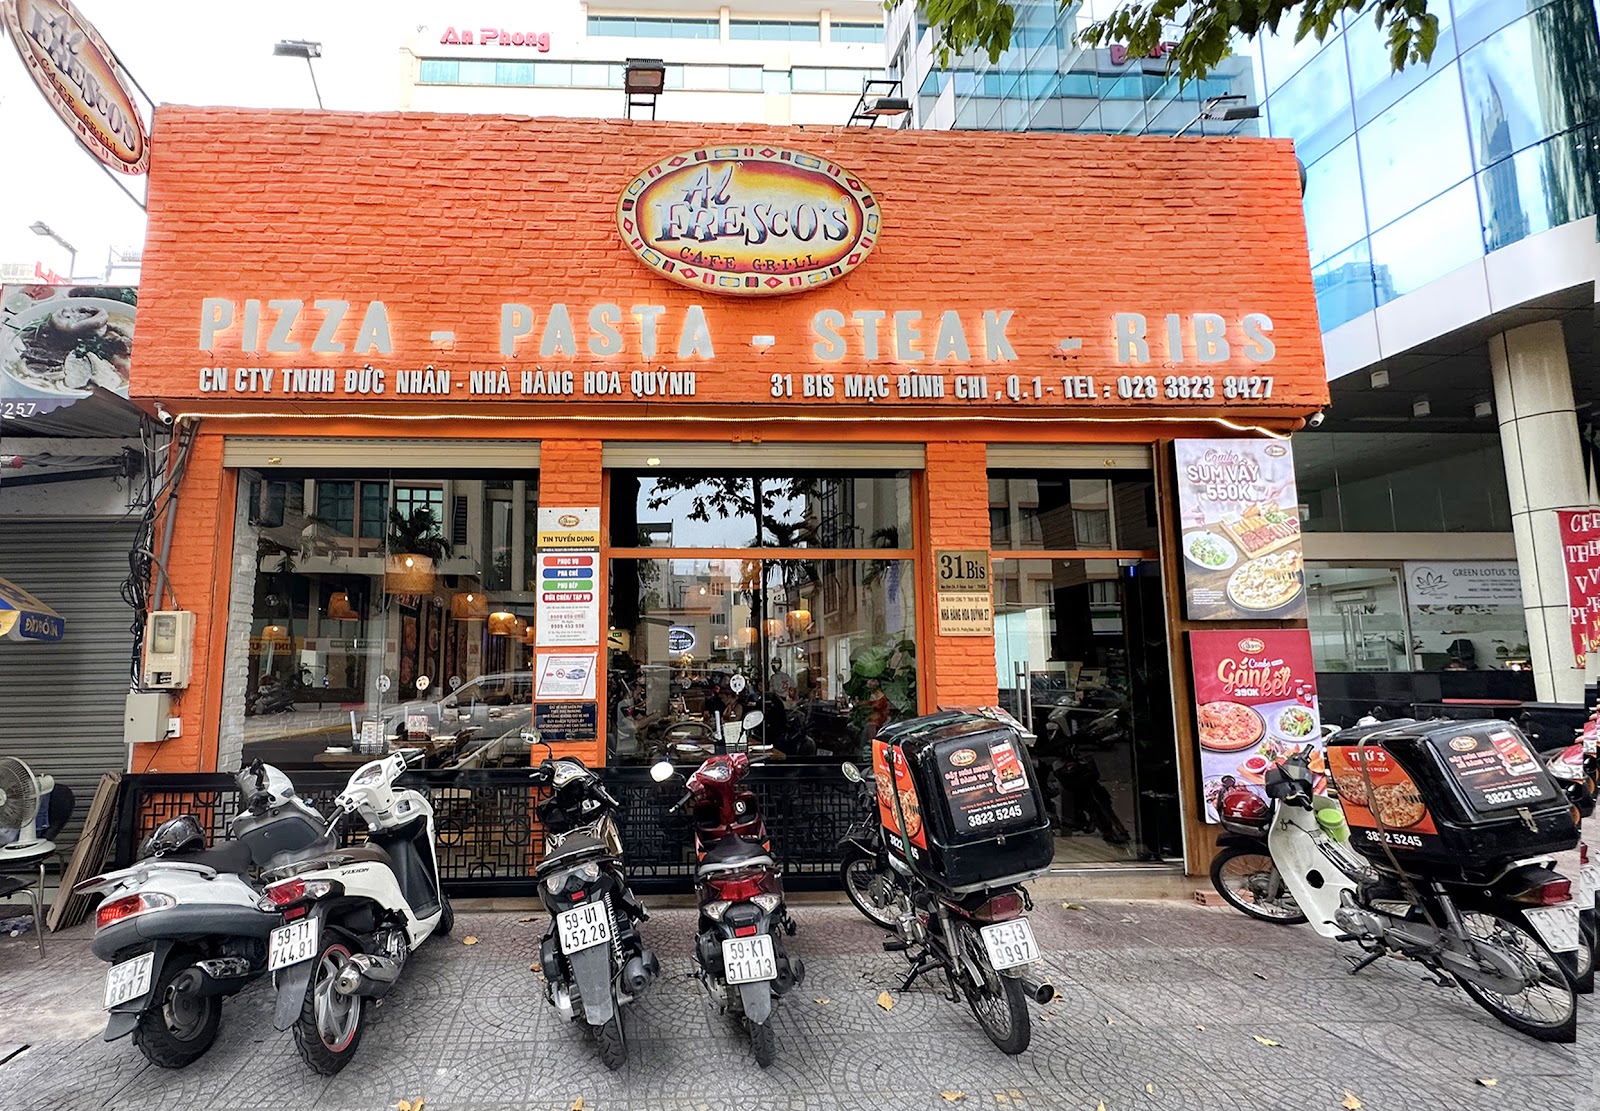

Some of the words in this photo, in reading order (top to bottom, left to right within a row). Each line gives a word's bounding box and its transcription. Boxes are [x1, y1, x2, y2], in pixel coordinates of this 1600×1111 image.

[440, 26, 473, 45] An
[480, 28, 550, 53] Phong
[682, 165, 734, 208] Al
[199, 298, 393, 354] PIZZA
[500, 303, 715, 358] PASTA
[813, 309, 1019, 361] STEAK
[1115, 312, 1276, 363] RIBS
[199, 367, 229, 392] CN
[234, 367, 275, 393] CTY
[281, 368, 336, 393] TNHH
[344, 363, 385, 394] ĐỨC
[396, 365, 451, 394] NHÂN
[469, 365, 511, 395] NHÀ
[520, 365, 574, 395] HÀNG
[583, 370, 622, 395] HOA
[630, 365, 696, 398] QUỲNH
[770, 372, 793, 398] 31
[802, 373, 835, 398] BIS
[844, 374, 890, 403] MẠC
[1117, 375, 1158, 399] 028
[1164, 376, 1215, 399] 3823
[1223, 376, 1273, 399] 8427
[1204, 447, 1239, 462] Combo
[1187, 463, 1225, 483] SUM
[1206, 483, 1252, 501] 550K
[940, 554, 965, 580] 31
[965, 560, 986, 579] Bis
[1452, 568, 1478, 577] GREEN
[1480, 568, 1506, 577] LOTUS
[1484, 790, 1514, 805] 3822
[1513, 785, 1542, 800] 5245
[968, 811, 995, 827] 3822
[996, 805, 1023, 820] 5245
[1365, 830, 1392, 843] 382
[1393, 833, 1422, 847] 5245
[564, 906, 598, 931] 59-U1
[277, 920, 310, 947] 59-T1
[564, 923, 607, 950] 452.28
[272, 938, 314, 969] 744.81
[731, 938, 765, 960] 59-K1
[995, 941, 1030, 965] 9997
[729, 959, 773, 980] 511.13
